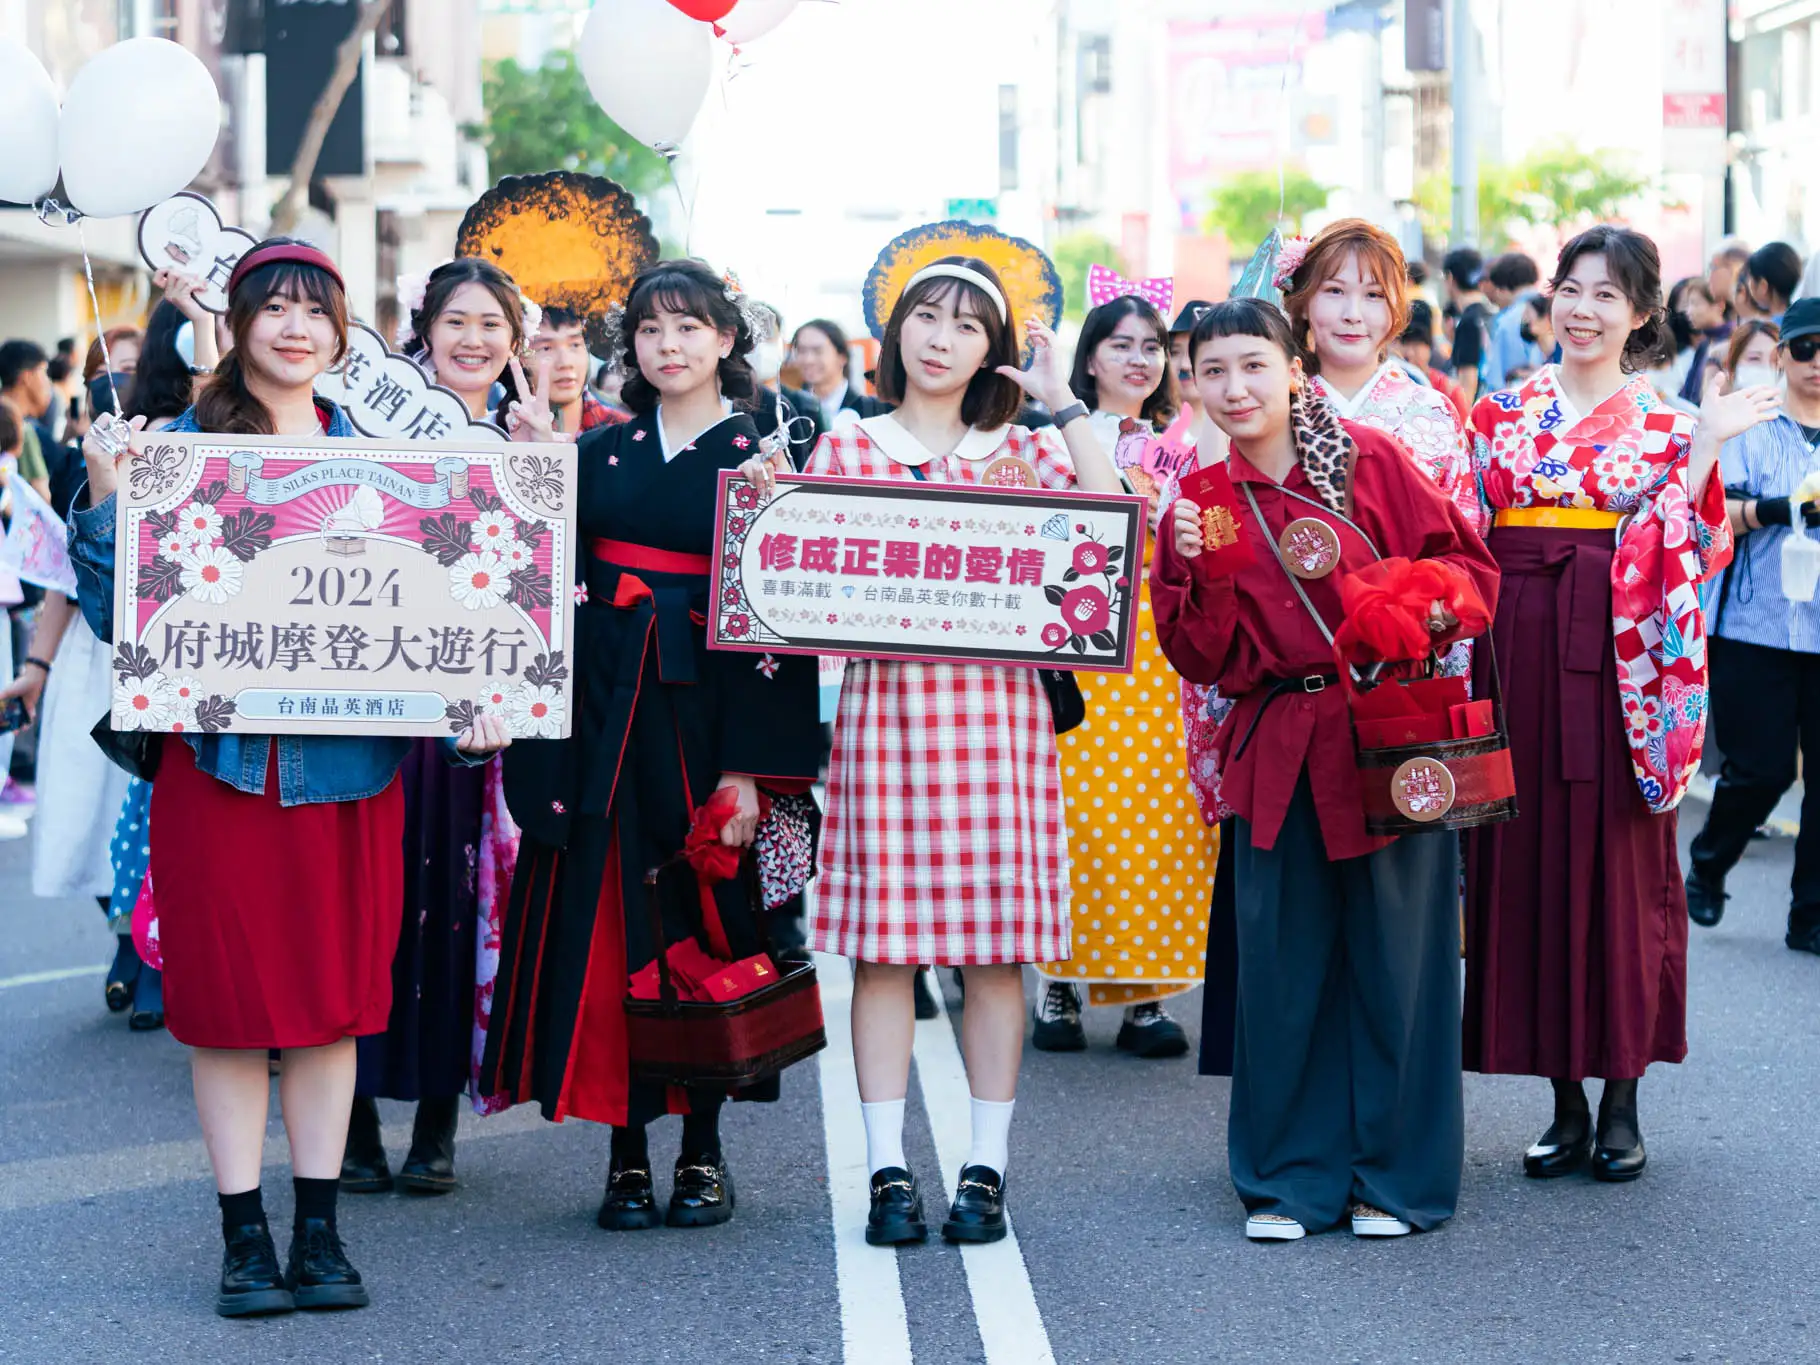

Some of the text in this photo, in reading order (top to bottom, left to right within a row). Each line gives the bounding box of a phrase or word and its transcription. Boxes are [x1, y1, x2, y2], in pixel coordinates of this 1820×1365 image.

[282, 467, 415, 499] SILKS PLACE TAINAN
[758, 532, 1046, 586] 修成正果的愛情
[288, 565, 405, 607] 2024
[761, 579, 1023, 610] 喜事滿載 台南晶英愛你數十載
[160, 619, 528, 676] 府城摩登大遊行
[277, 697, 406, 717] 台南晶英酒店
